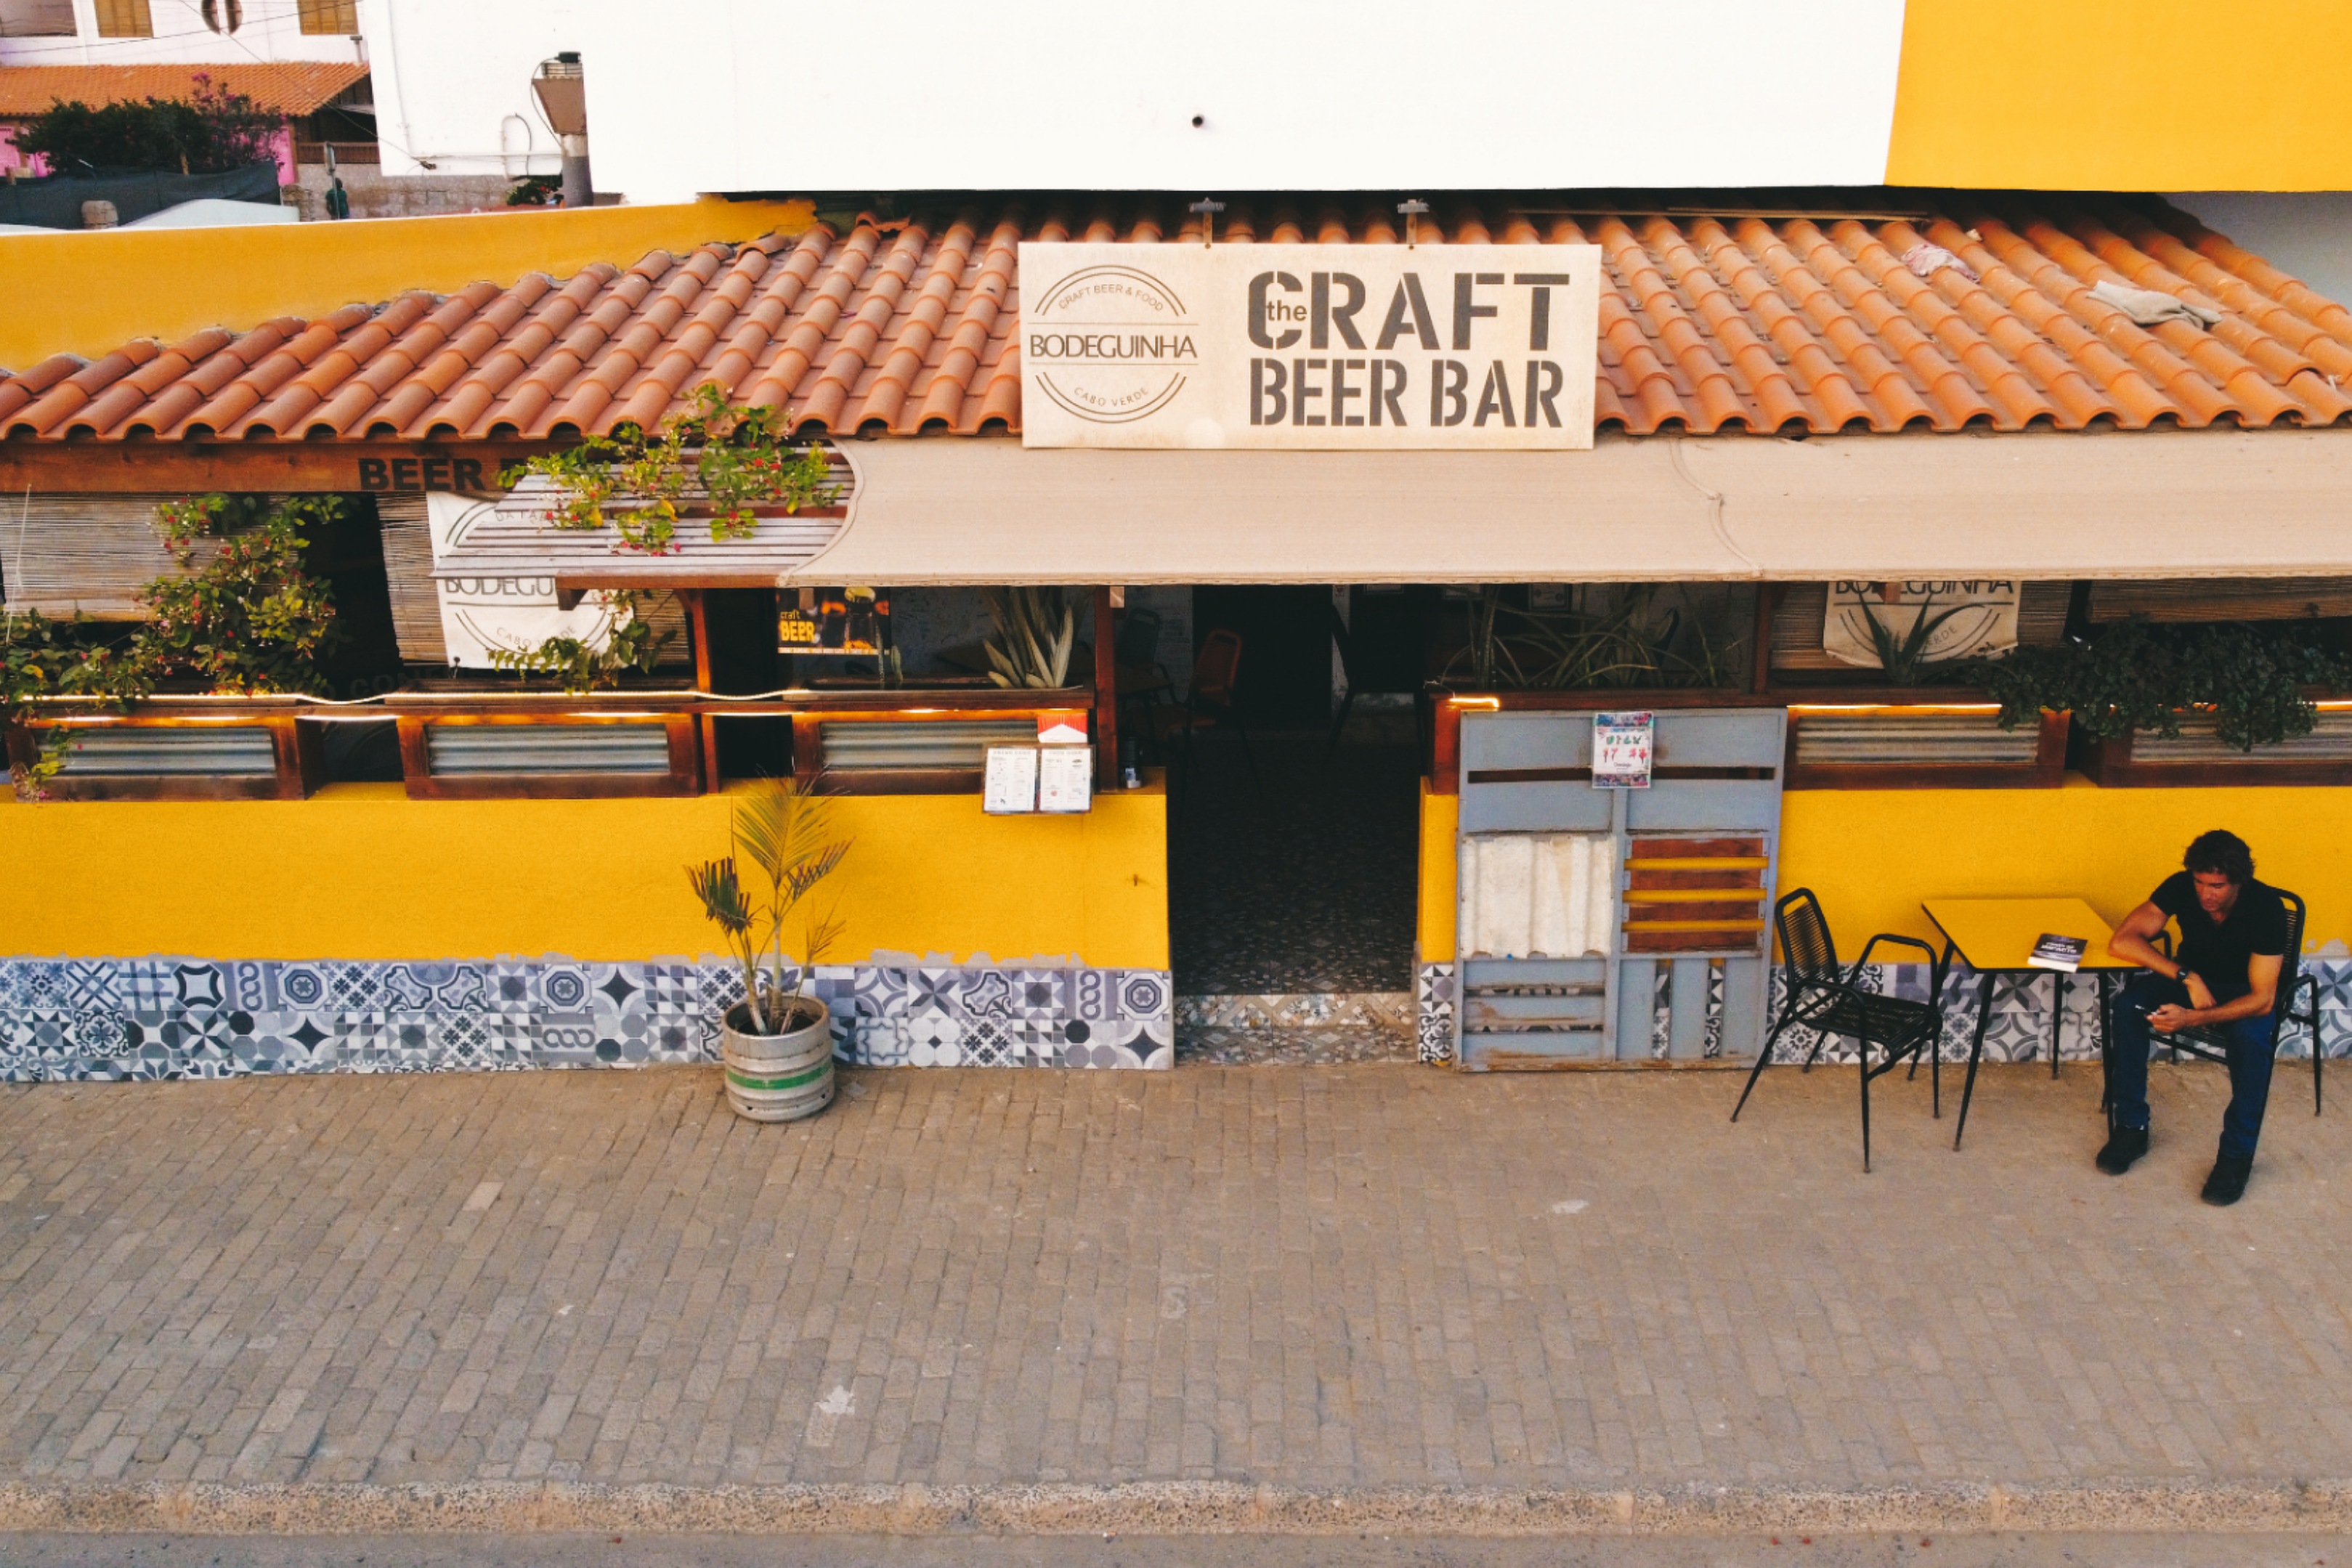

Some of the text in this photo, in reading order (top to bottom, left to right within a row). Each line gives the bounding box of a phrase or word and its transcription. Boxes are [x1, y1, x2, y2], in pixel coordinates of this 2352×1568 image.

[1058, 287, 1090, 309] CRAFT
[1094, 284, 1123, 293] BEER
[1135, 290, 1164, 312] FOOD
[1248, 271, 1570, 351] CRAFT
[1265, 299, 1307, 321] the
[1029, 334, 1198, 358] BODEGUINHA
[1074, 386, 1149, 407] CABO VERDE
[1249, 358, 1564, 428] BEER BAR
[358, 458, 485, 491] BEER
[445, 577, 554, 596] BODEGU
[497, 627, 532, 648] CABO
[779, 620, 815, 641] BEER
